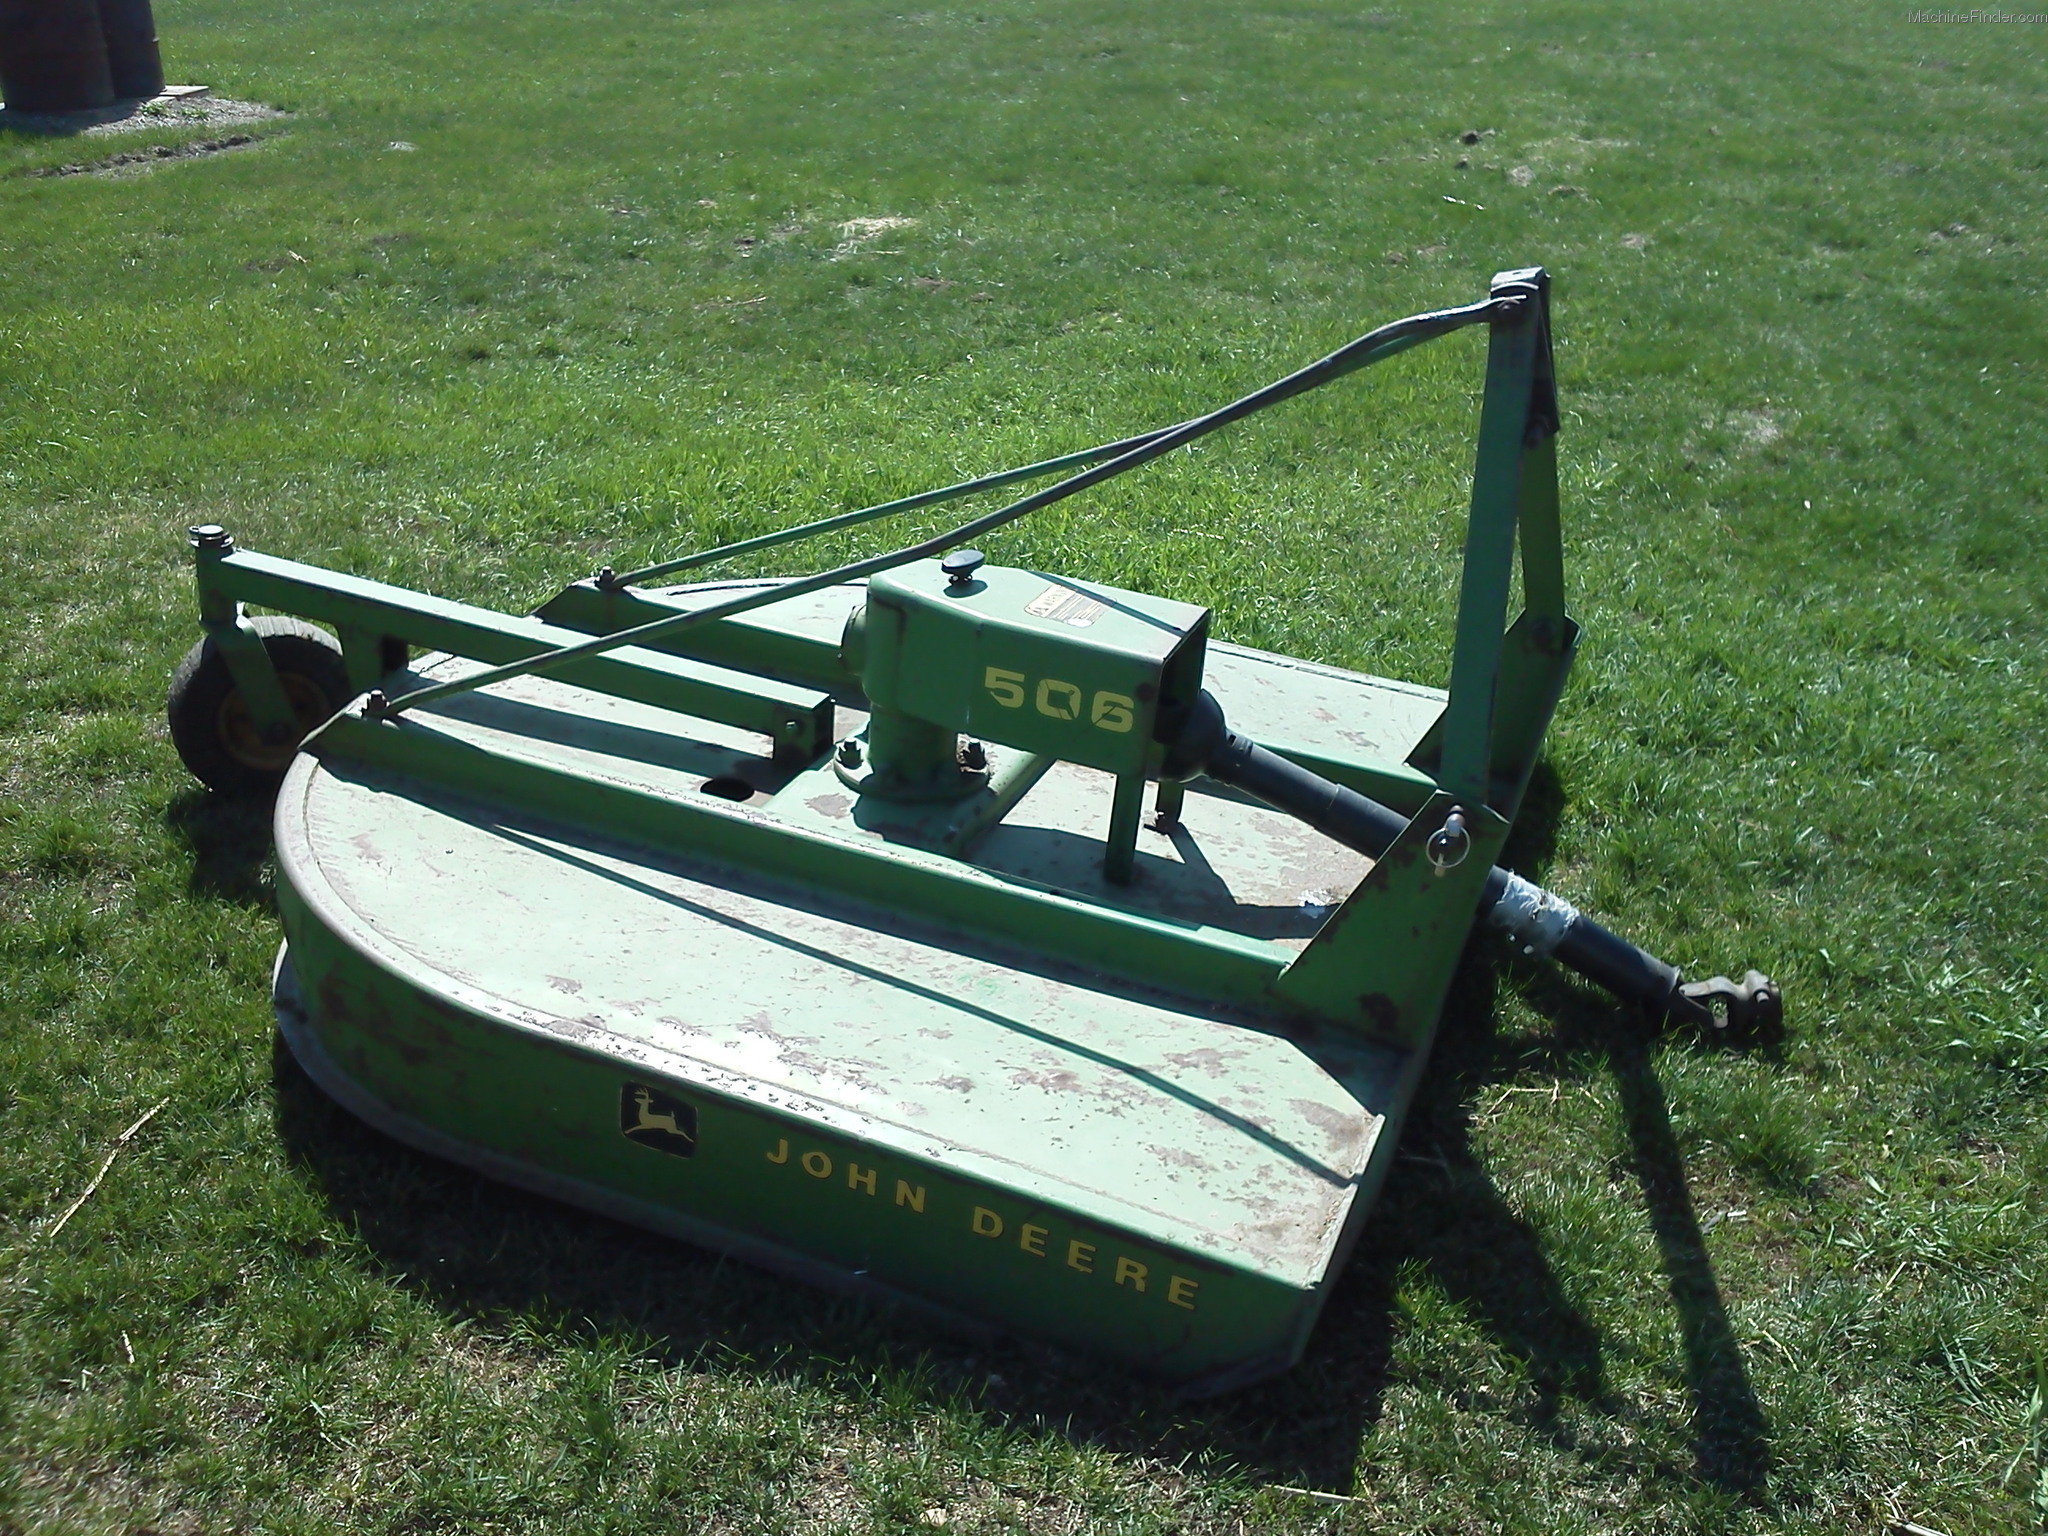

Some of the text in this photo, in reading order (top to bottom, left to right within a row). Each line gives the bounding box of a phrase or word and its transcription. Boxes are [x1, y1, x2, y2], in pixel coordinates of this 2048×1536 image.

[985, 666, 1134, 733] 506
[767, 1138, 1199, 1310] JOHN DEERE
